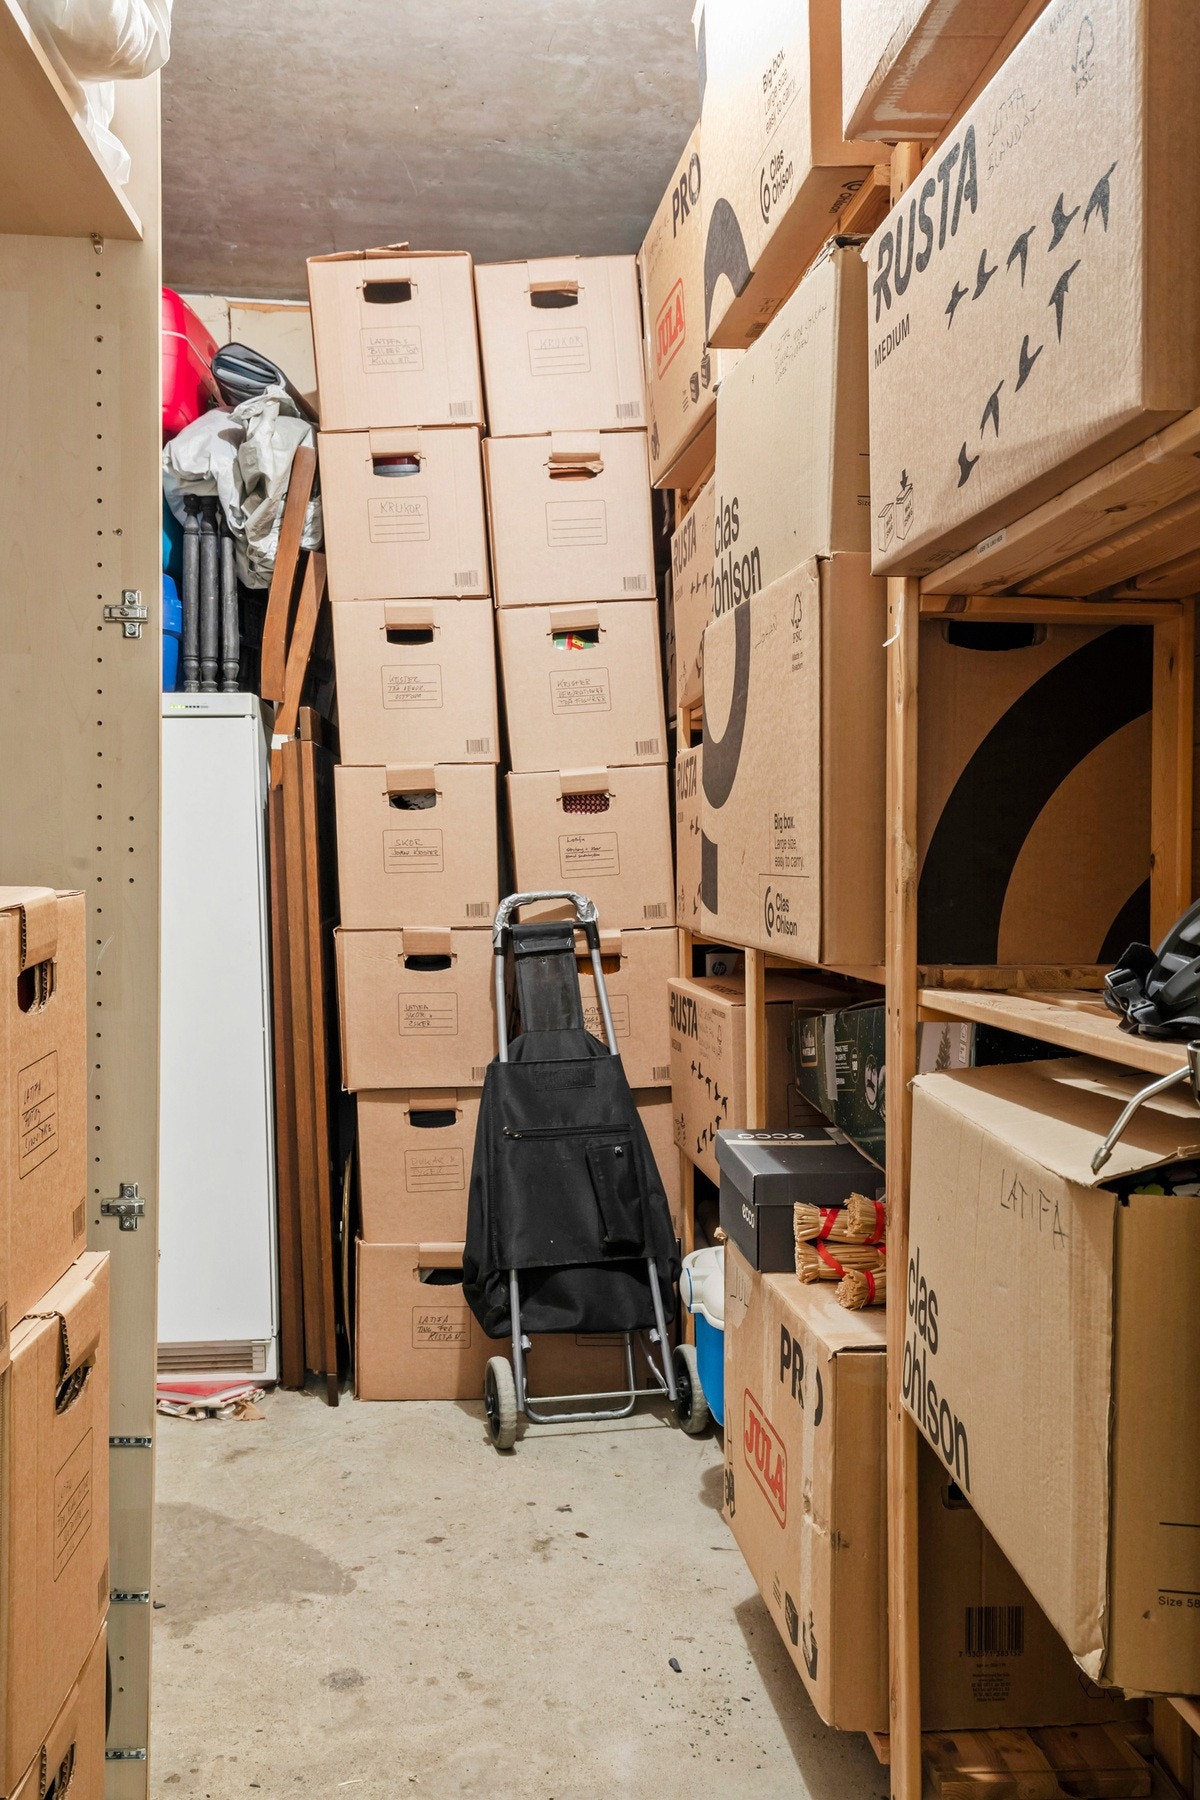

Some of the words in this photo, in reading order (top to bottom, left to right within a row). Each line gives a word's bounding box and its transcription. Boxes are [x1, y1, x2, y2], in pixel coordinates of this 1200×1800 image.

[762, 69, 773, 94] Big
[773, 46, 786, 74] box.
[769, 149, 784, 180] Clas
[771, 160, 794, 205] Ohlson
[672, 151, 701, 240] PRO
[872, 123, 978, 324] RUSTA
[656, 293, 684, 368] JULA
[873, 312, 911, 370] MEDIUM
[673, 511, 697, 582] RUSTA
[714, 495, 740, 559] clas
[714, 545, 762, 618] ohlson
[677, 754, 697, 801] RUSTA
[774, 813, 783, 834] Big
[783, 813, 796, 830] box.
[774, 838, 787, 853] Large
[774, 856, 785, 870] easy
[790, 857, 805, 871] carry.
[775, 891, 790, 913] Clas
[775, 914, 798, 937] Ohlson
[669, 990, 699, 1042] RUSTA
[741, 1203, 755, 1229] ecco
[1000, 1168, 1069, 1249] LATIFA
[908, 1246, 939, 1356] clas
[902, 1333, 971, 1495] ohlson
[745, 1408, 785, 1512] JULA
[1158, 1595, 1183, 1607] Size
